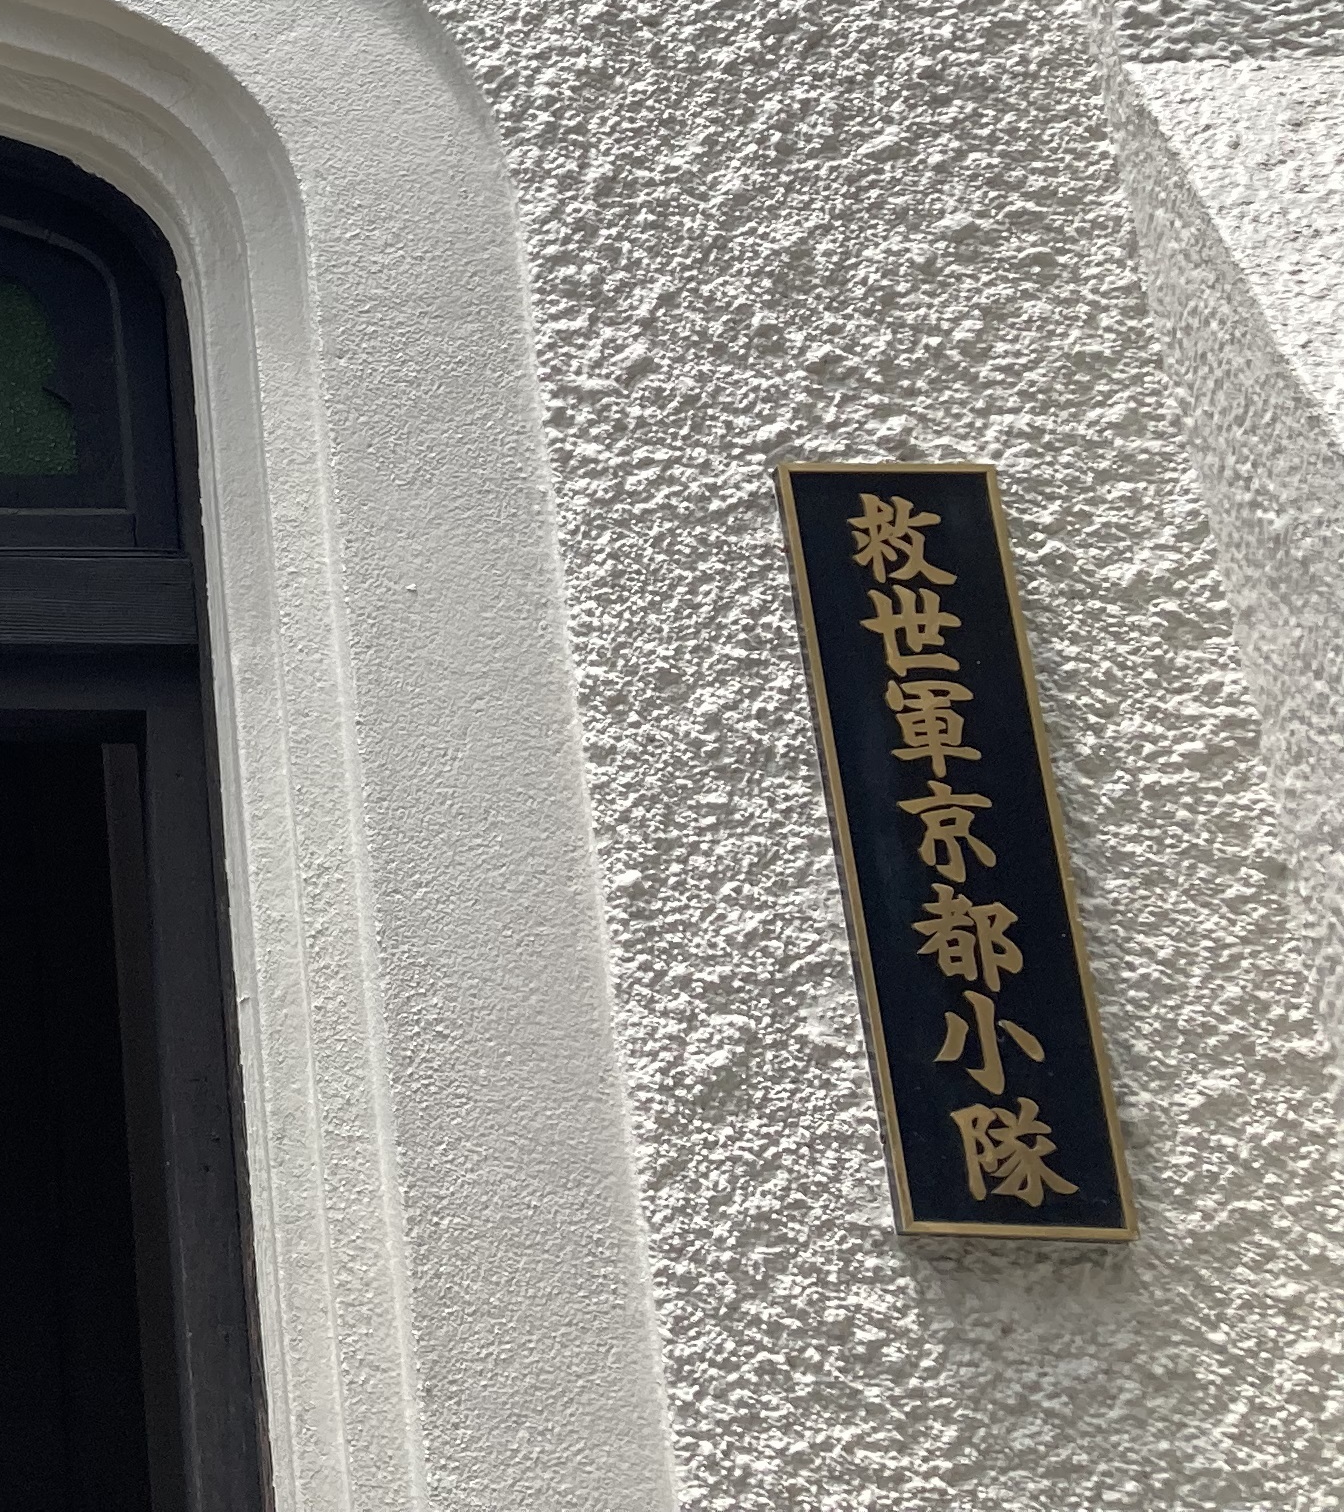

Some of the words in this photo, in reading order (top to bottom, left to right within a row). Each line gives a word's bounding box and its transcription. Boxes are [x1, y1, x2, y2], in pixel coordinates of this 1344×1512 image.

[850, 493, 1078, 1207] 救世軍京都小隊
